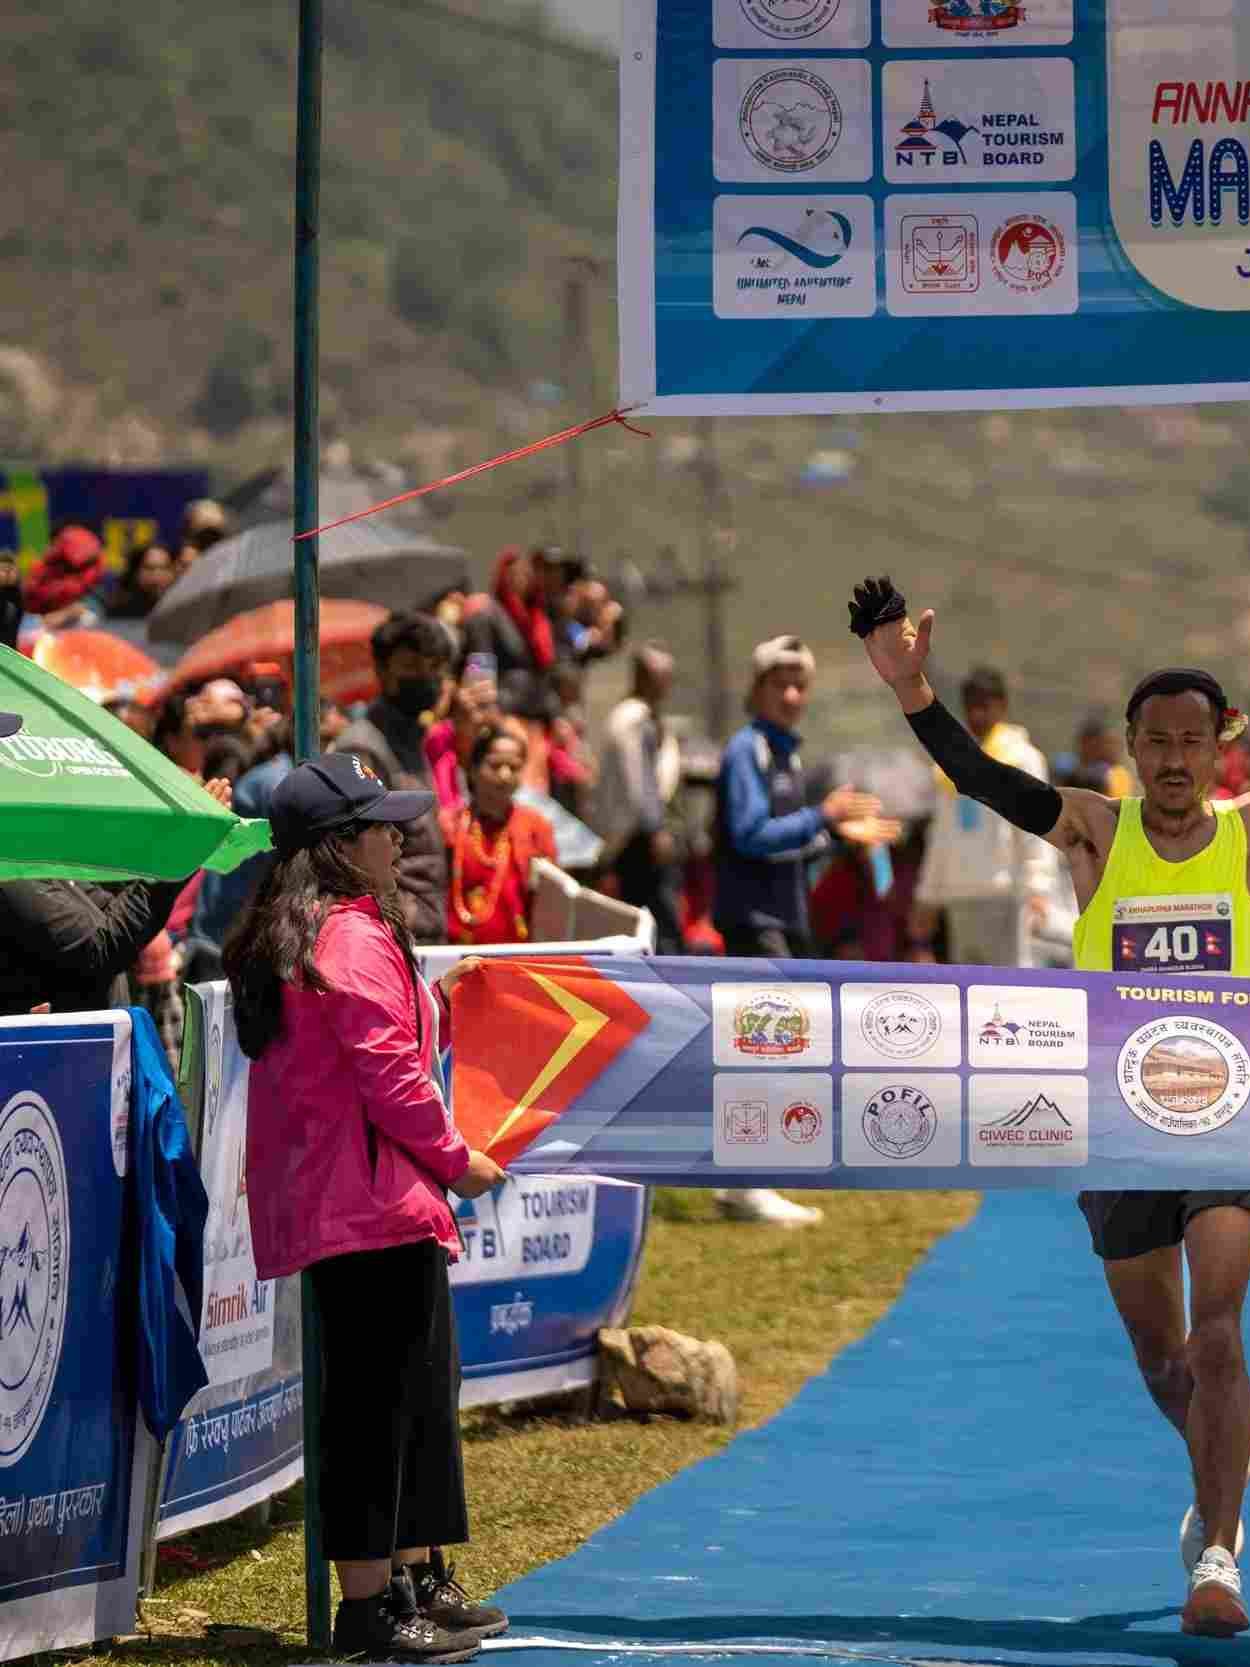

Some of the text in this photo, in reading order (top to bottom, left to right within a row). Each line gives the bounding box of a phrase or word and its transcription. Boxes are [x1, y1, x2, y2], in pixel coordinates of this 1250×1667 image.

[982, 114, 1040, 127] NEPAL
[982, 132, 1065, 146] TOURISM
[983, 152, 1045, 165] BOARD
[1144, 925, 1199, 962] 40
[1116, 985, 1214, 1004] TOURISM
[1027, 1020, 1061, 1029] NEPAL
[1028, 1030, 1076, 1039] TOURISM
[1028, 1040, 1064, 1048] BOARD
[868, 1088, 930, 1118] POFIL
[980, 1130, 1073, 1141] CIWEC CLINIC
[520, 1188, 589, 1219] TOURISM
[522, 1233, 572, 1263] BOARD
[206, 1279, 270, 1330] Simrik Air
